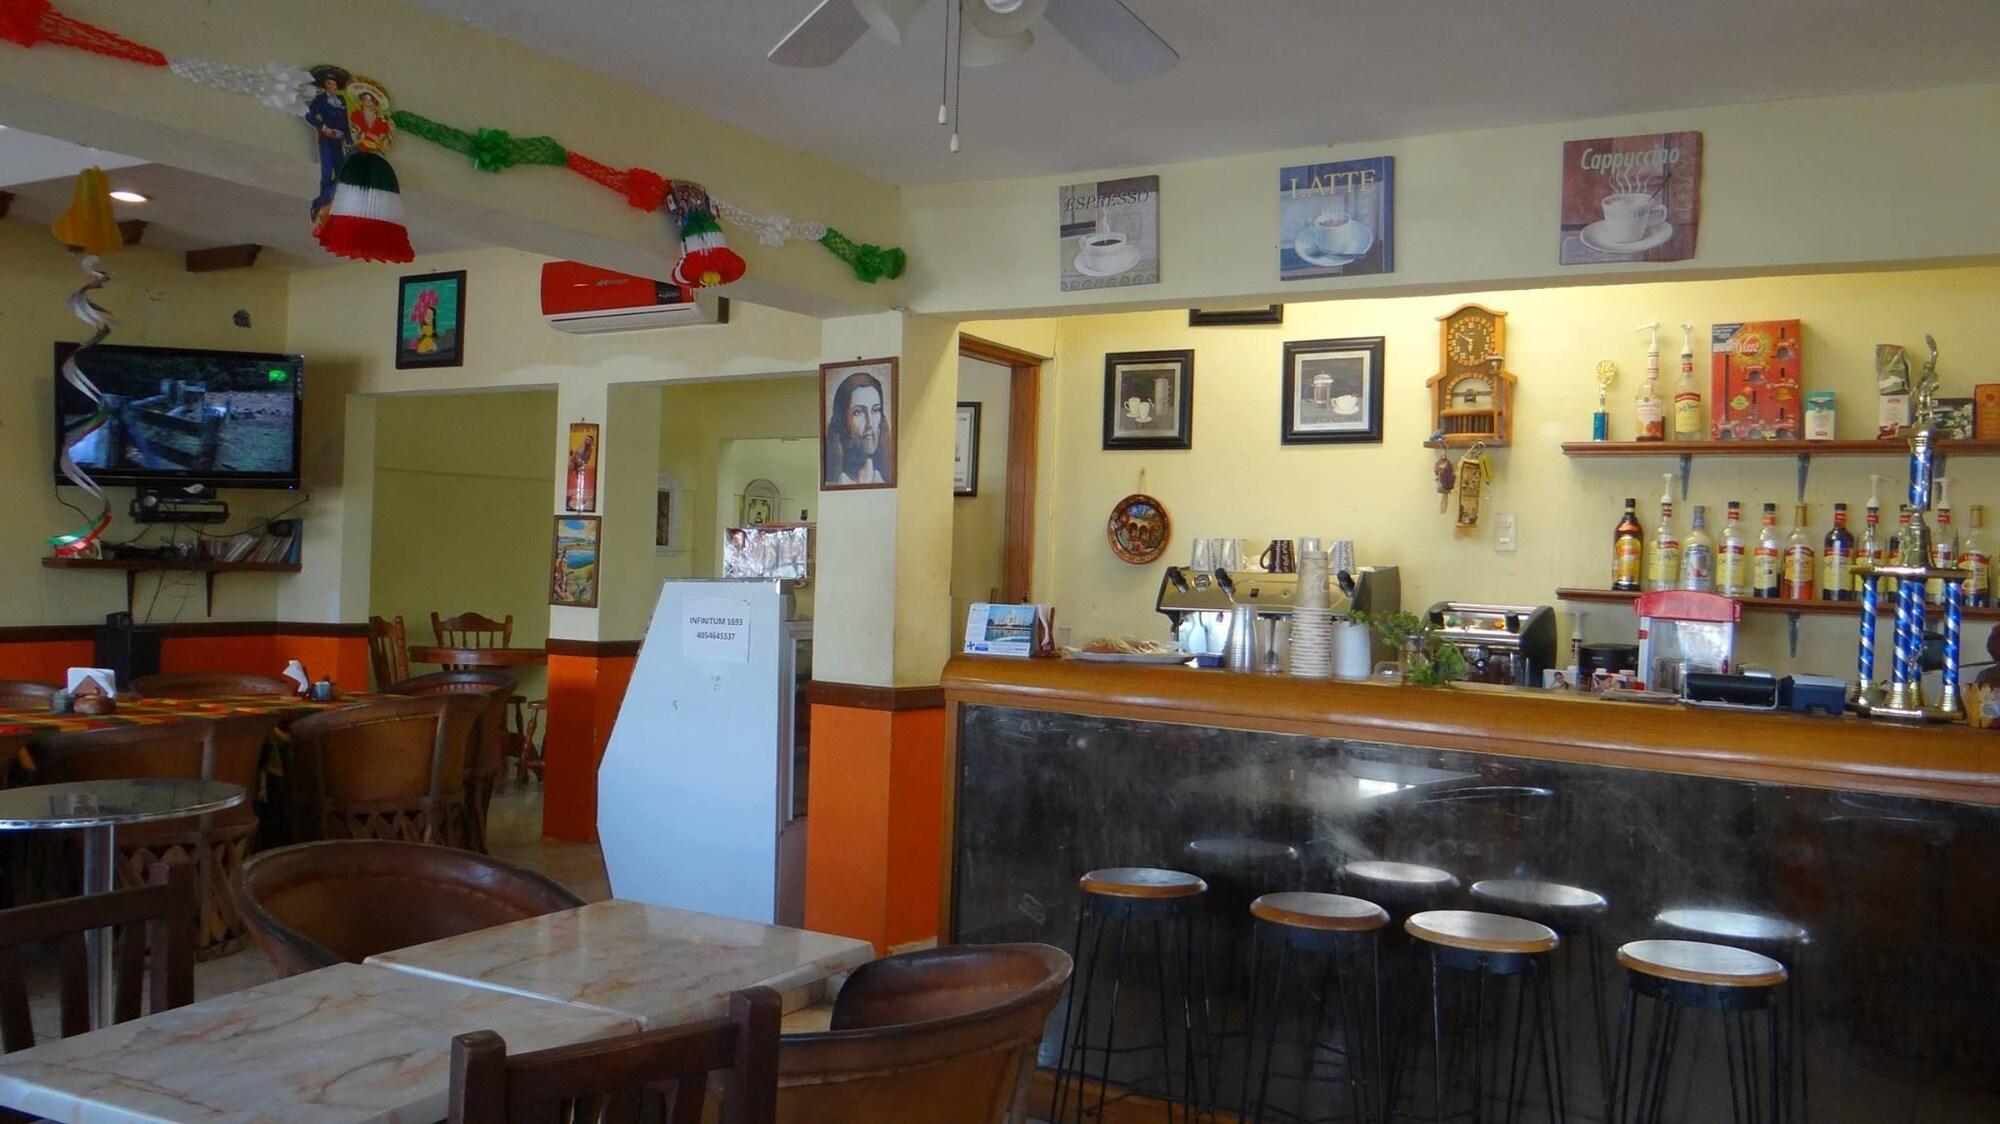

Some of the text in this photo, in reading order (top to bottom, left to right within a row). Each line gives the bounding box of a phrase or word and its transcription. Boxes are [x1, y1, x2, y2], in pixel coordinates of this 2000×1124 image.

[1289, 169, 1377, 199] LATTE
[1063, 190, 1150, 213] ESPRESSO
[689, 617, 743, 626] INFINITUM 1693
